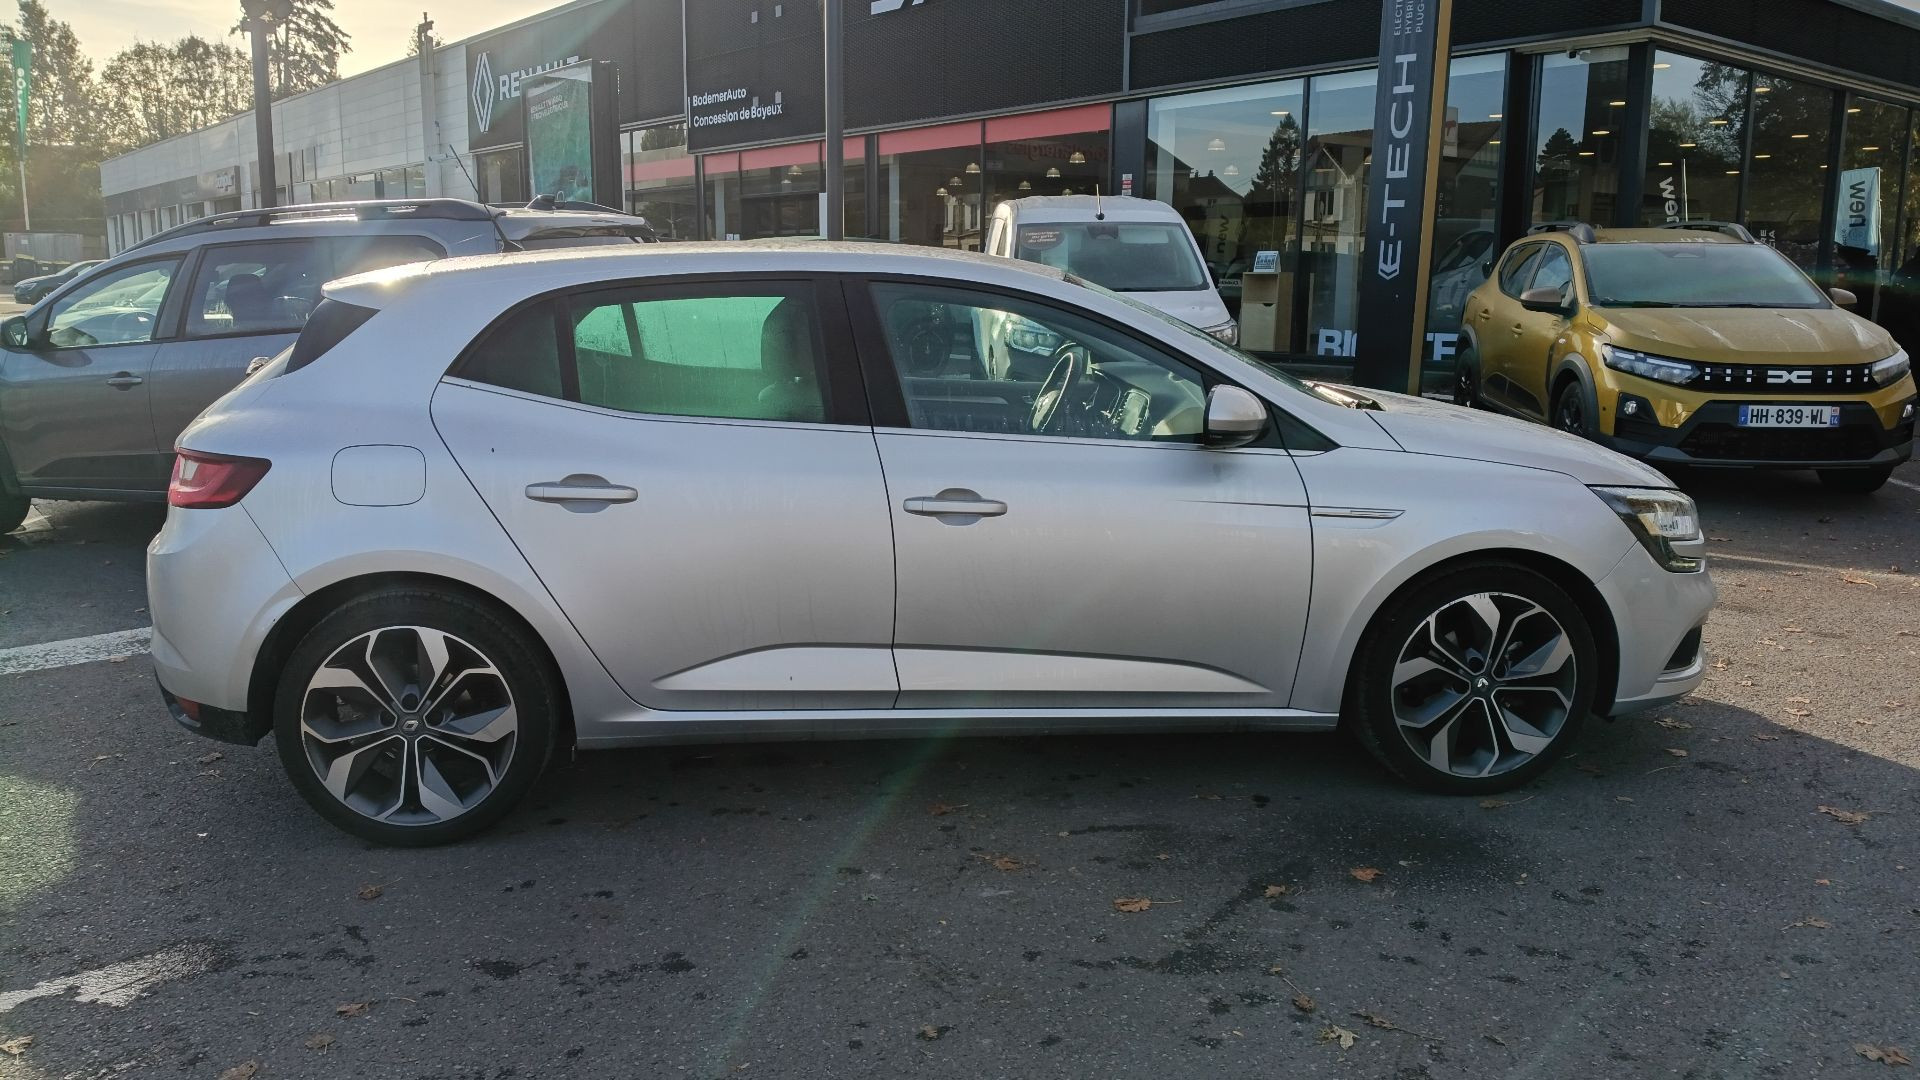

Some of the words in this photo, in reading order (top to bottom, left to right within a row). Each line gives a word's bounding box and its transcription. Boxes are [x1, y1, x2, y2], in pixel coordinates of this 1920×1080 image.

[692, 88, 746, 107] BodemerAuto
[693, 109, 738, 128] Concession
[739, 107, 750, 120] de
[751, 103, 783, 120] Bayeux
[1378, 53, 1417, 281] E-TECH
[1749, 408, 1828, 425] HH-839-WL
